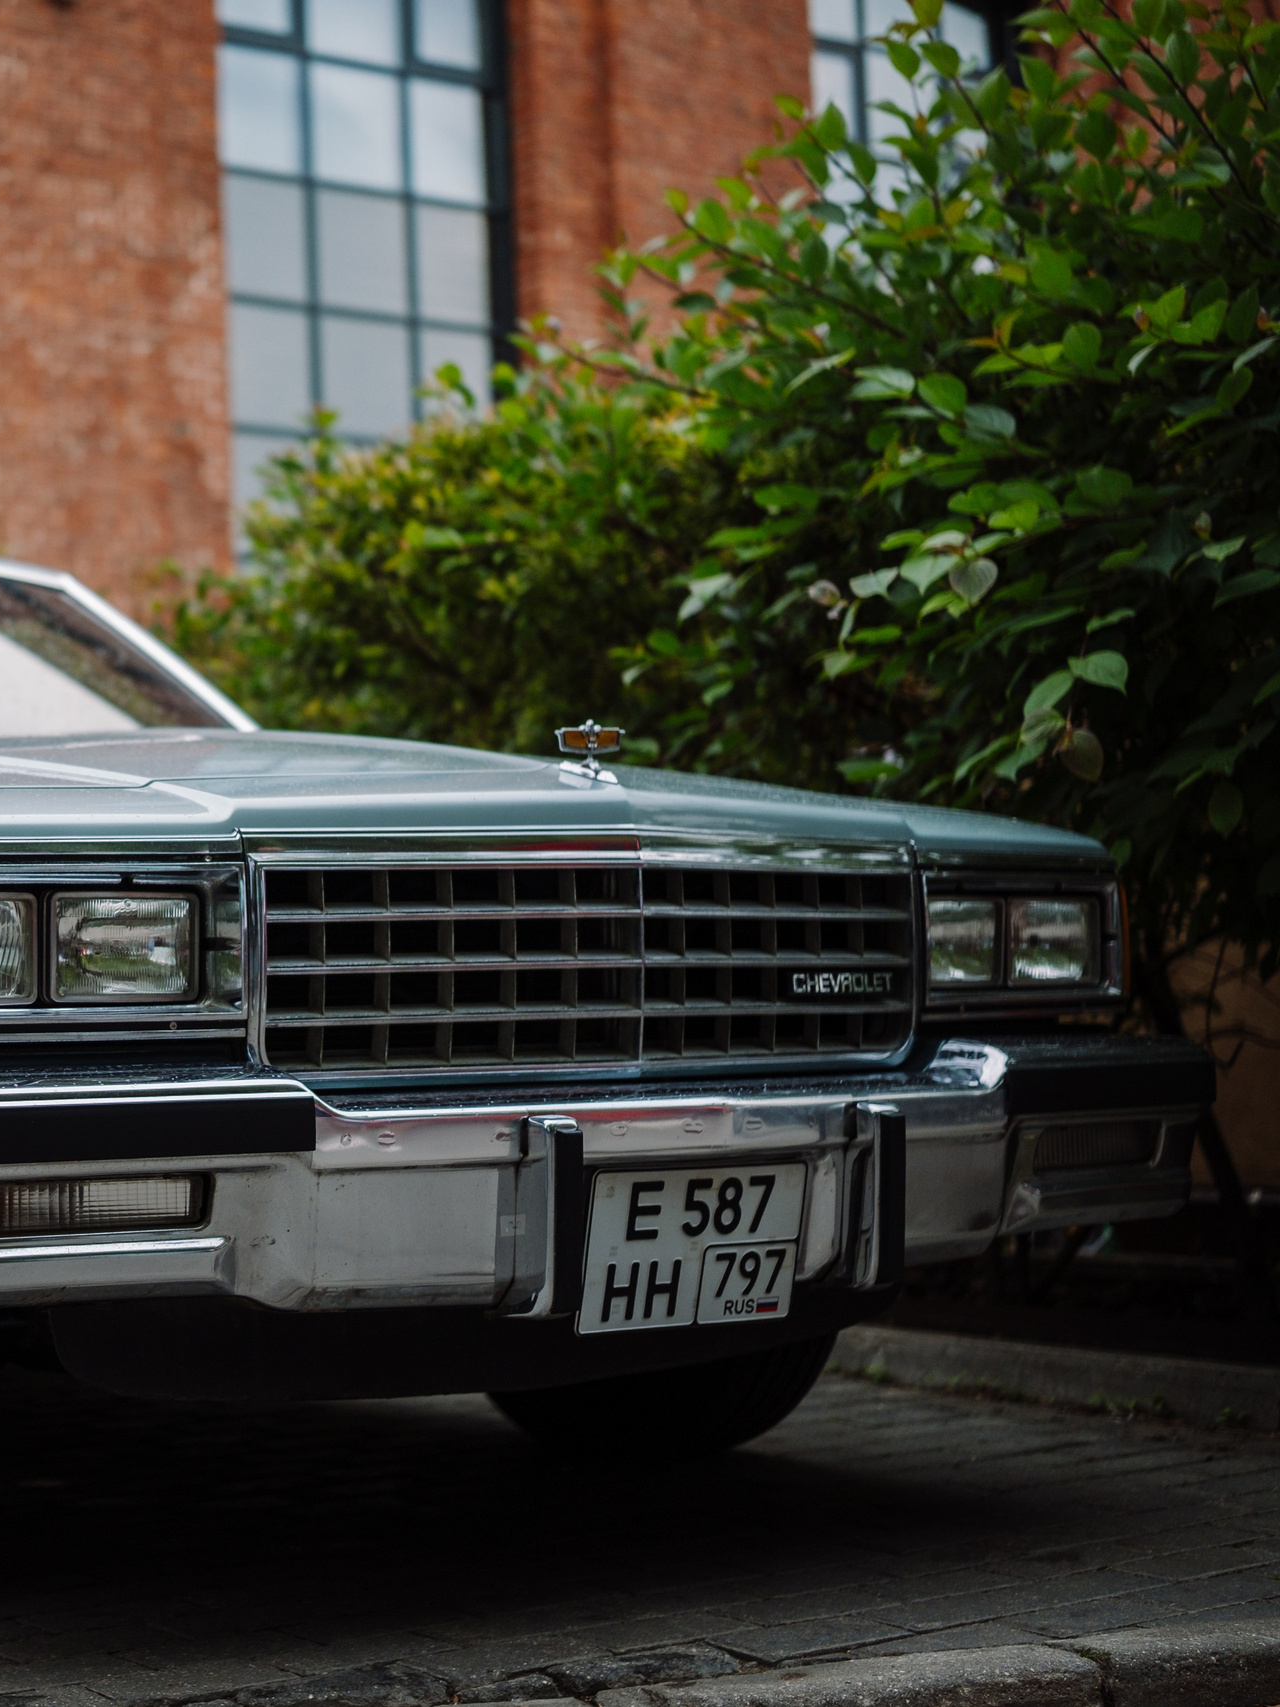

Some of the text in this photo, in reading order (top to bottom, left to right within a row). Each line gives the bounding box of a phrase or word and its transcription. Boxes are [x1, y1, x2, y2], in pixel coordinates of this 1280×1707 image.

[793, 972, 892, 993] CHEVROLET
[626, 1174, 776, 1241] E 587
[600, 1248, 787, 1322] HH 797
[723, 1298, 755, 1316] RUS
